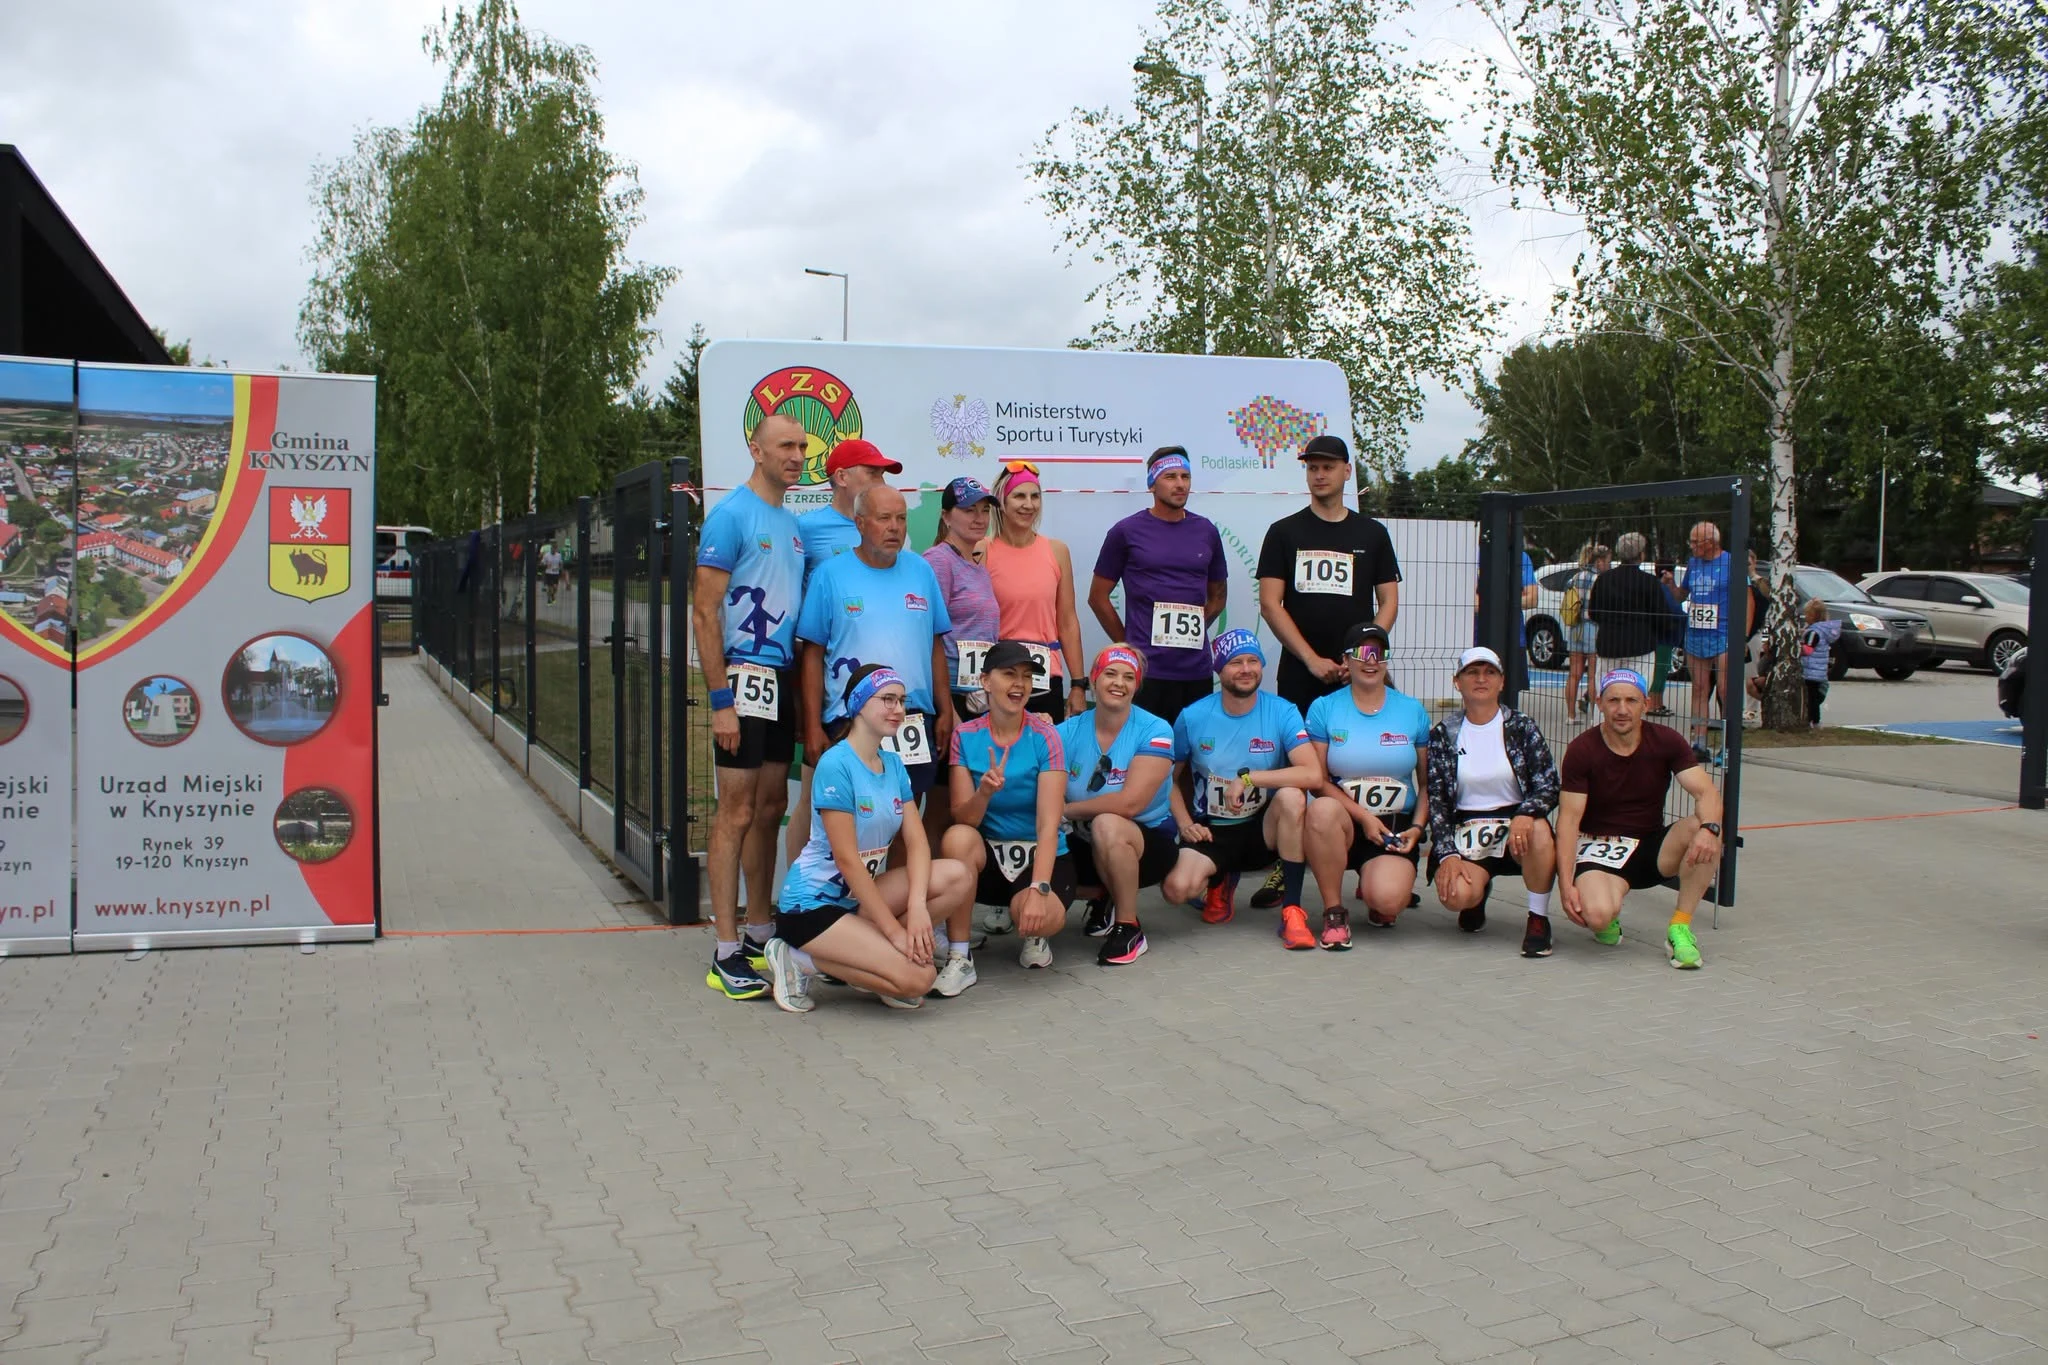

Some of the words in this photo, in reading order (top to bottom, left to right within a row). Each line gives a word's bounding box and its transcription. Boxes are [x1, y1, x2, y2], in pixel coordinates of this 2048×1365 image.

[760, 373, 842, 406] LZS
[996, 401, 1107, 420] Ministerstwo
[271, 431, 350, 450] Gmina
[996, 425, 1053, 445] Sportu
[1059, 426, 1063, 442] i
[1068, 426, 1143, 446] Turystyki
[249, 452, 370, 472] KNYSZYN
[1201, 455, 1260, 470] Podlaskie
[1302, 559, 1348, 583] 105
[1160, 612, 1201, 637] 153
[1691, 609, 1714, 622] 152
[728, 673, 775, 705] 155
[100, 775, 167, 798] Urząd
[183, 774, 263, 797] Miejski
[1350, 783, 1402, 808] 167
[110, 805, 127, 818] w
[143, 798, 255, 823] Knyszynie
[143, 837, 193, 855] Rynek
[203, 836, 225, 850] 39
[1462, 825, 1509, 849] 169
[1578, 842, 1629, 861] 133
[115, 855, 172, 870] 19-120
[183, 855, 249, 872] Knyszyn
[95, 894, 271, 919] www.knyszyn.pl
